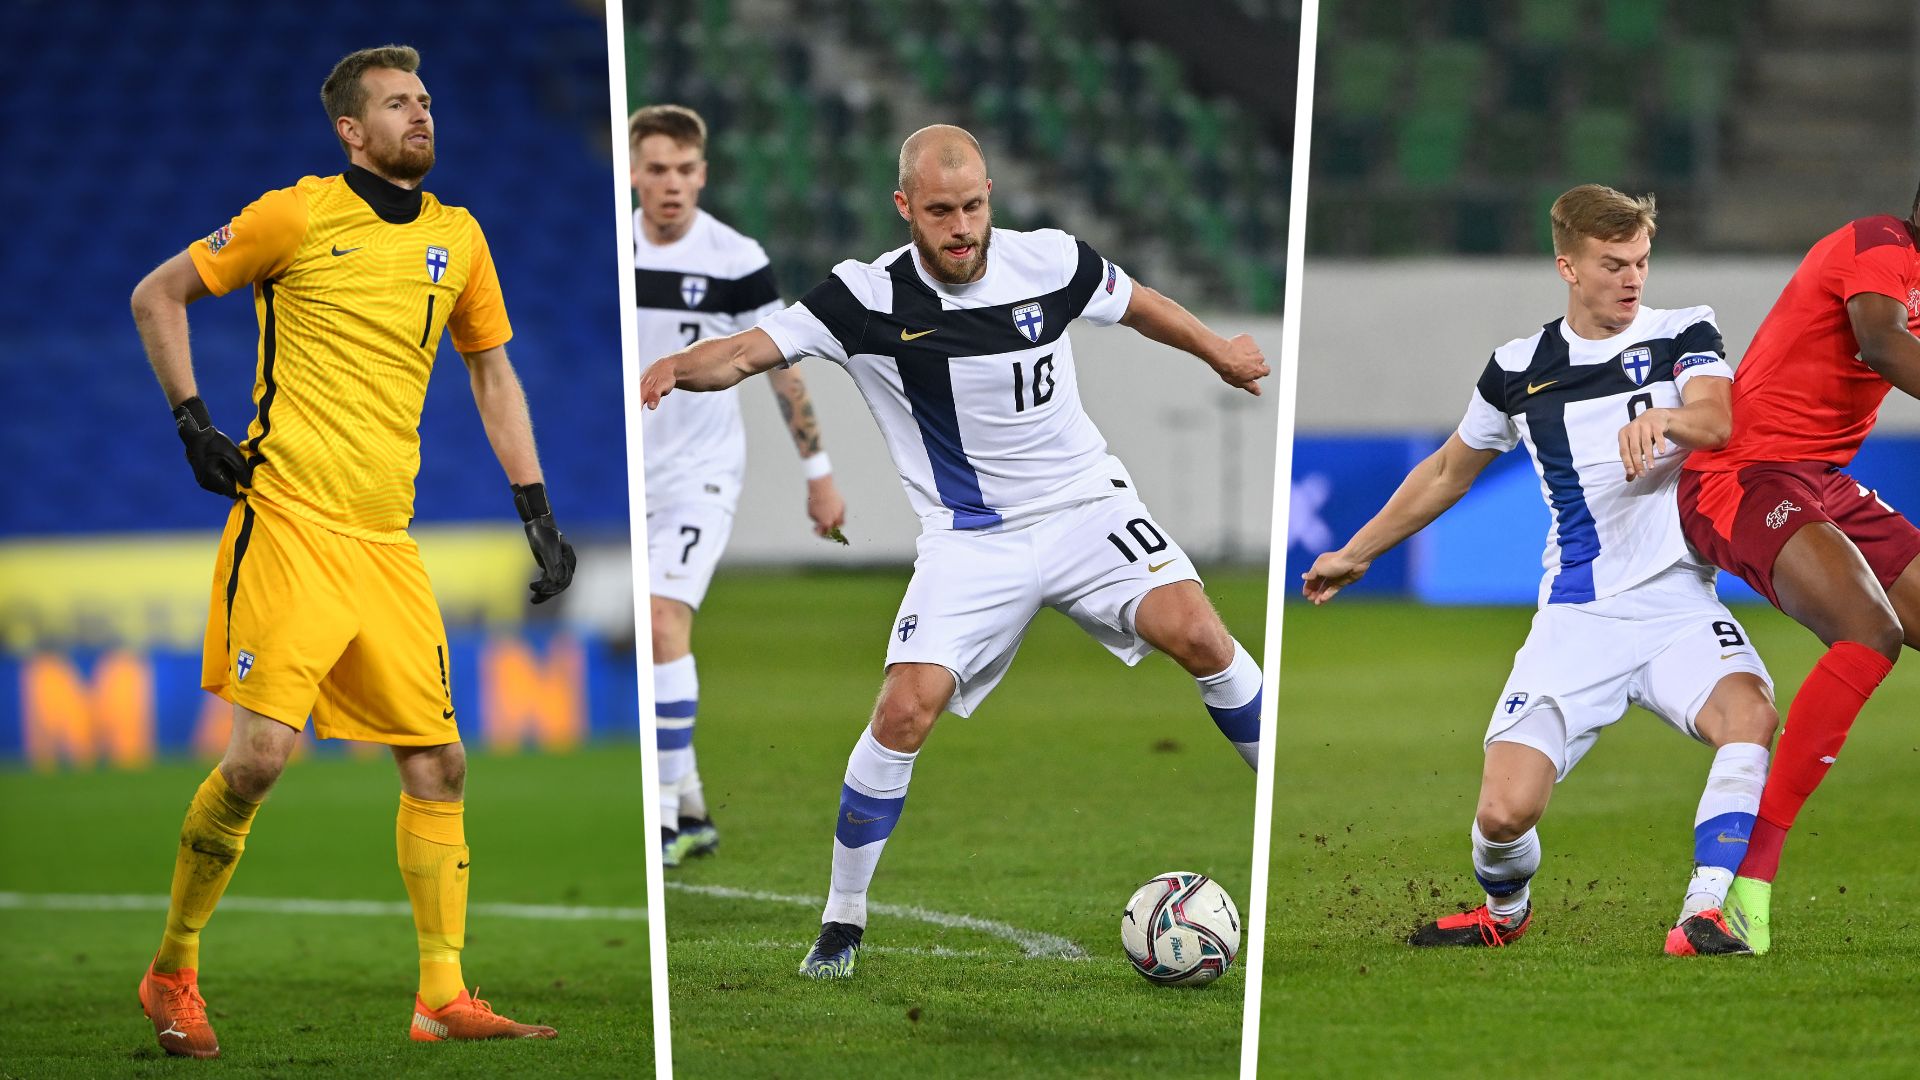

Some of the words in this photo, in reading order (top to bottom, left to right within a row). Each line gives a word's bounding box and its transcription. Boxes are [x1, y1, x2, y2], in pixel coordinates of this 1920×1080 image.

[420, 294, 435, 348] 1
[1682, 358, 1717, 367] RESPEC
[1012, 353, 1055, 412] 10
[680, 526, 701, 564] 7
[1107, 518, 1168, 563] 10
[1712, 621, 1745, 647] 9
[414, 1012, 448, 1039] PUMA
